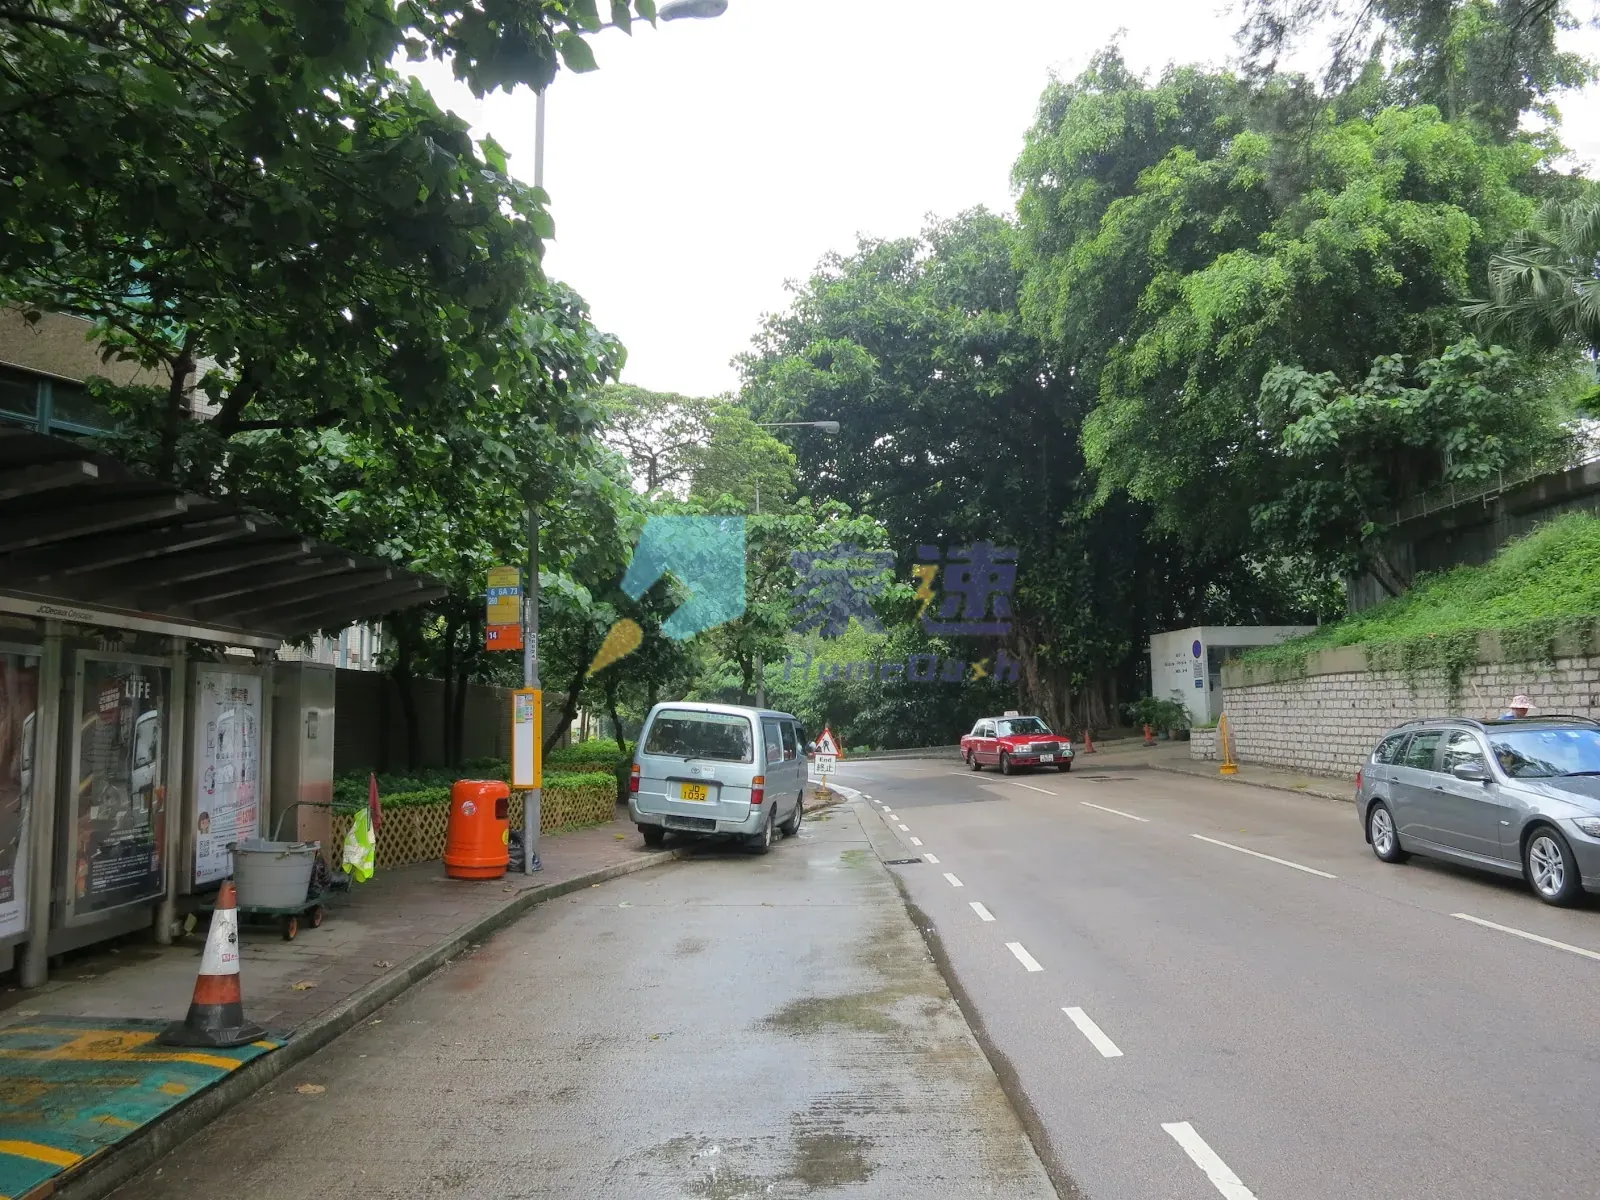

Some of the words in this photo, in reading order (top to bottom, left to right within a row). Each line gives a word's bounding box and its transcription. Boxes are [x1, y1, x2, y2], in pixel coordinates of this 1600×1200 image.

[498, 588, 508, 596] 6A
[510, 587, 518, 595] 73
[489, 631, 497, 639] 14
[125, 680, 151, 699] LIFE
[816, 763, 834, 773] 終止
[683, 791, 706, 801] 1033
